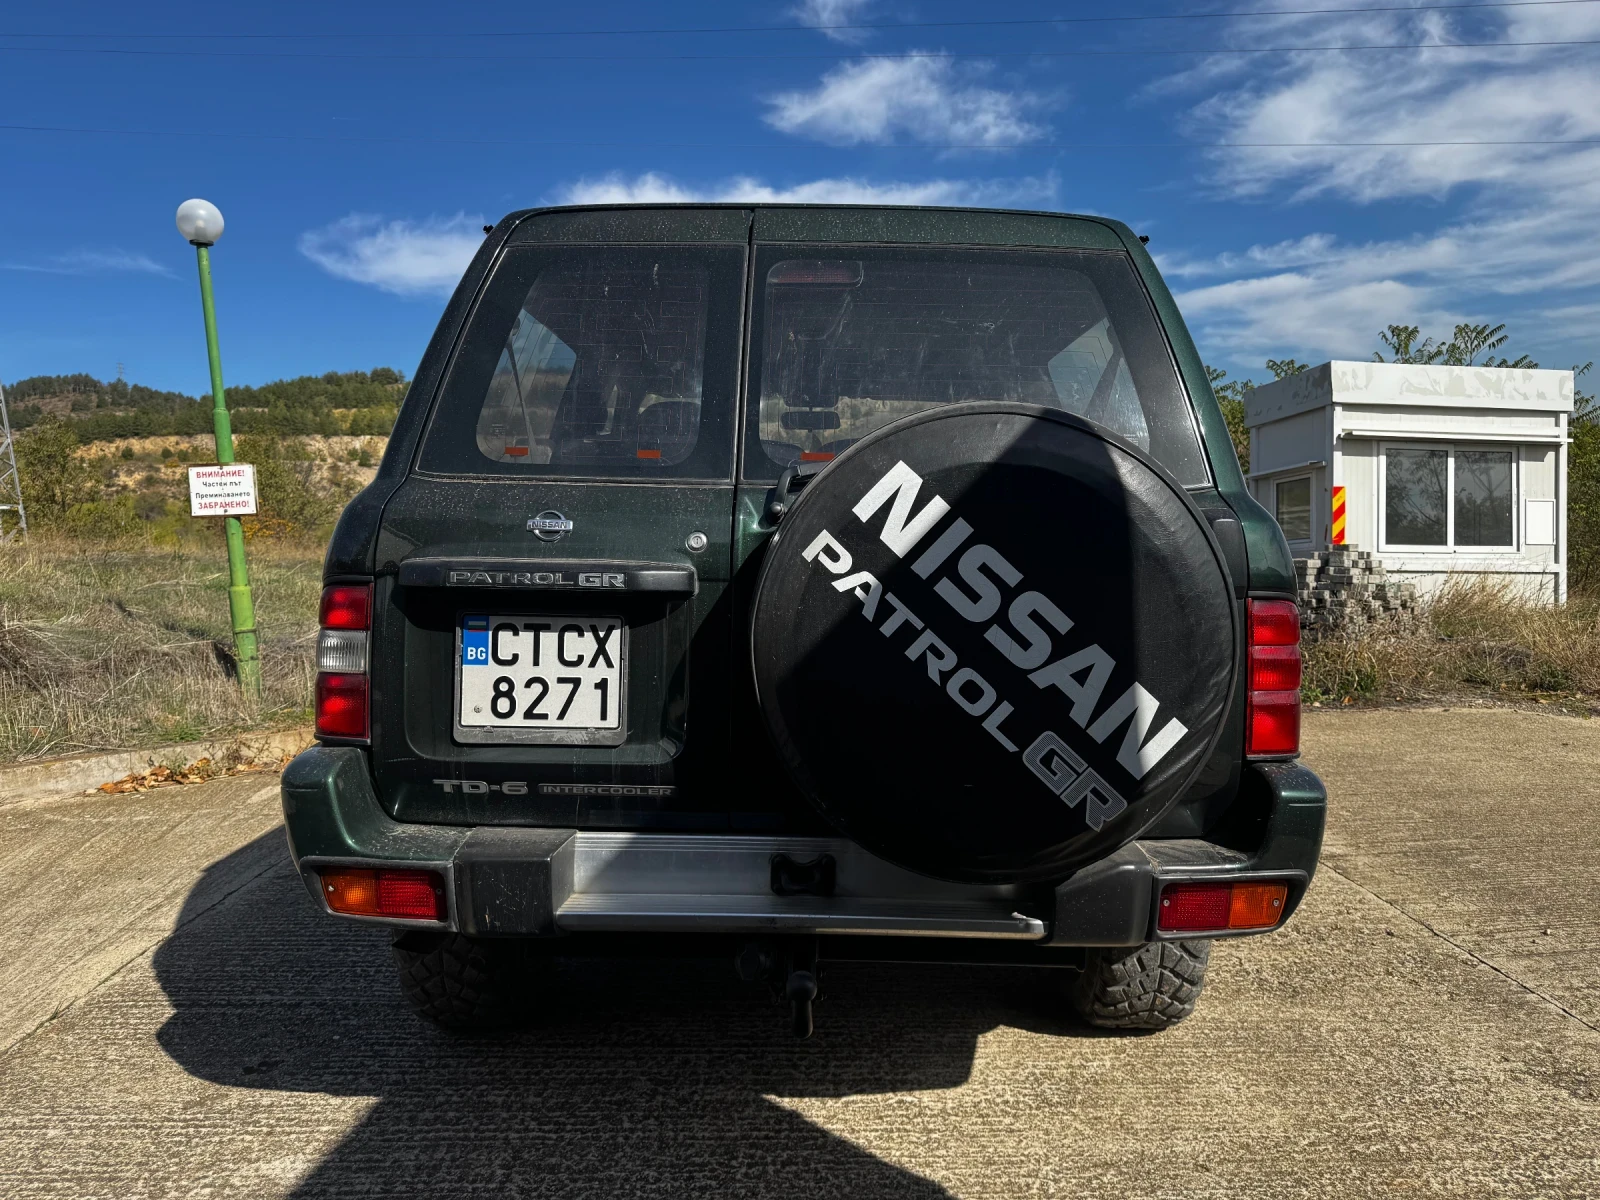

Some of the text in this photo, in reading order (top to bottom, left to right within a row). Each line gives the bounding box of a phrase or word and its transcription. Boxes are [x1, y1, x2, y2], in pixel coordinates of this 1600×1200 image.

[196, 469, 245, 479] ВНИМАНИЕ!
[195, 491, 251, 500] Преминаването
[198, 500, 250, 510] ЗАБРАНЕНО!
[531, 520, 568, 529] NISSAN
[450, 571, 626, 588] PATROL GR
[851, 459, 1189, 781] NISSAN
[467, 646, 487, 660] BG
[491, 621, 616, 669] CTCX
[801, 529, 1128, 832] PATROL GR
[490, 675, 609, 721] 8271
[433, 779, 672, 796] TD-6 INTERCOOLER
